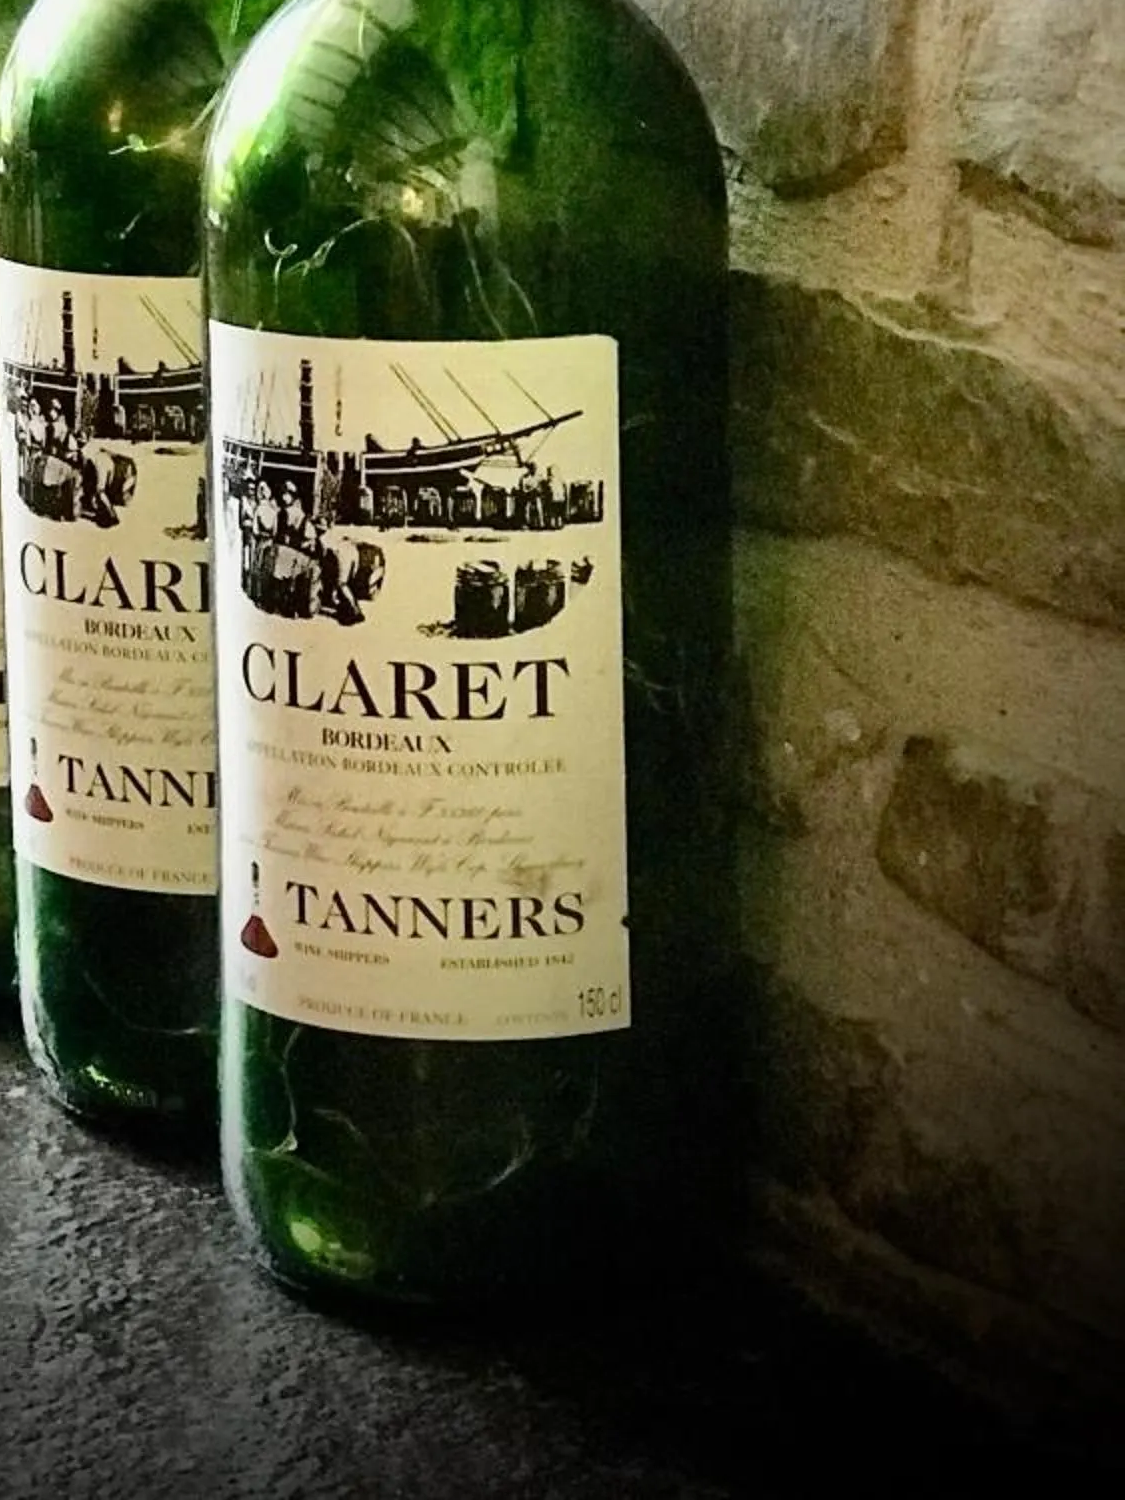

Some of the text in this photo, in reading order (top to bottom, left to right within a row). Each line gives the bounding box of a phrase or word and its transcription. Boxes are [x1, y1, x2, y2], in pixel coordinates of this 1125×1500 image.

[84, 618, 198, 644] BORDEAUX
[242, 642, 571, 722] CLARET
[321, 727, 455, 754] BORDEAUX
[286, 881, 586, 941] TANNERS
[577, 986, 606, 1020] 150
